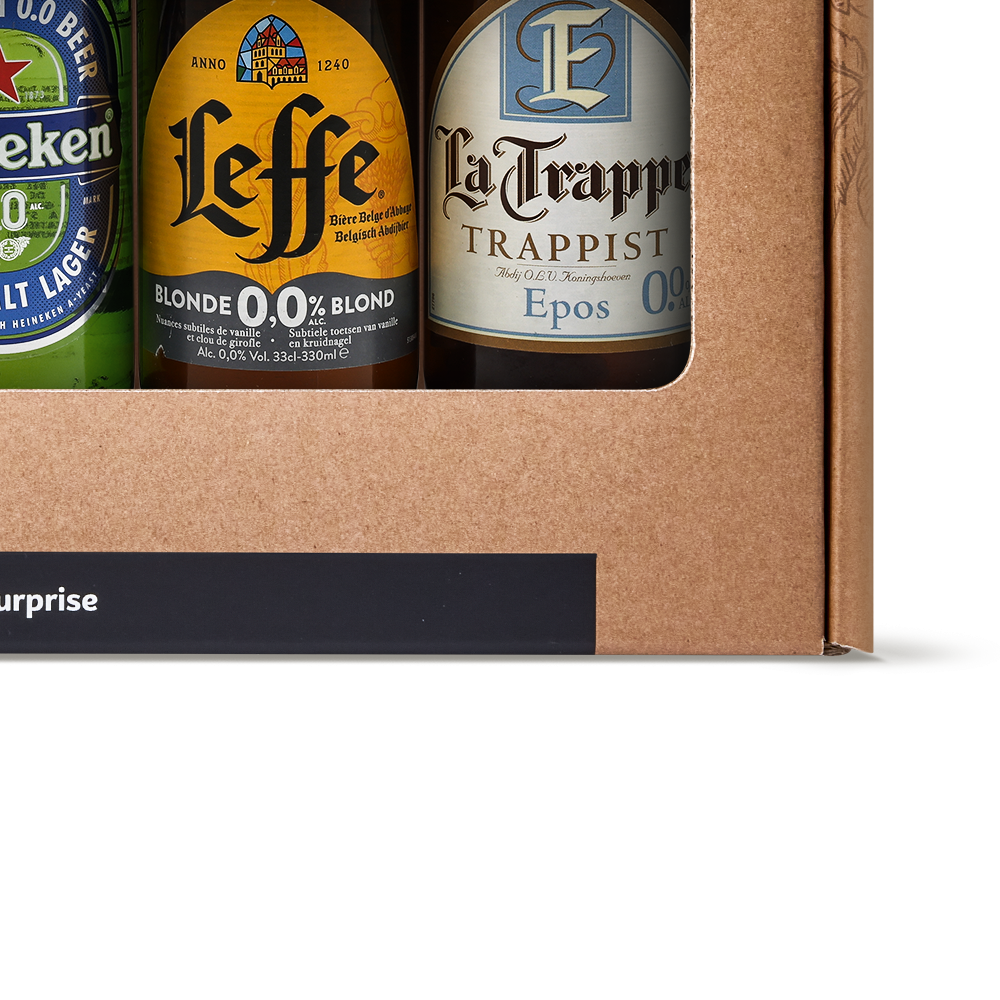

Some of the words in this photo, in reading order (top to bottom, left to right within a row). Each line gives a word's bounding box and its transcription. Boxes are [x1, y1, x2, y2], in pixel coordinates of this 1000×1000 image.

[55, 10, 99, 83] BEER
[191, 56, 226, 71] ANNO
[317, 58, 350, 72] 1240
[528, 7, 612, 113] E
[24, 91, 46, 100] 1873
[168, 92, 380, 264] Leffe
[435, 123, 497, 221] La
[493, 133, 691, 222] Trappe
[30, 203, 45, 211] ALC.
[83, 194, 101, 205] MARK
[329, 213, 357, 226] Bière
[359, 209, 384, 224] Belge
[335, 226, 377, 243] Belgisch
[461, 223, 669, 263] TRAPPIST
[38, 226, 98, 300] LAGER
[494, 266, 522, 283] Abdij
[558, 270, 632, 285] Koningshoeven
[12, 305, 64, 329] HEINEKEN
[68, 271, 99, 308] A-YEAST
[155, 284, 232, 316] BLONDE
[331, 288, 395, 316] BLOND
[523, 287, 610, 330] Epos
[678, 296, 691, 310] AL
[156, 313, 182, 330] Nuances
[183, 322, 215, 335] subtiles
[216, 325, 228, 336] de
[230, 327, 261, 338] vanille
[289, 327, 329, 338] Subtiele
[330, 324, 362, 335] toetsen
[363, 323, 377, 332] van
[378, 316, 399, 329] vanille
[308, 318, 327, 326] ALC.
[186, 332, 195, 342] et
[196, 333, 215, 345] clou
[216, 335, 228, 346] de
[228, 337, 261, 349] girofle
[303, 335, 352, 348] kruidnagel
[197, 346, 216, 359] Alc.
[218, 348, 247, 362] 0,0%
[249, 350, 270, 362] Vol.
[273, 348, 337, 362] 33cl-330ml
